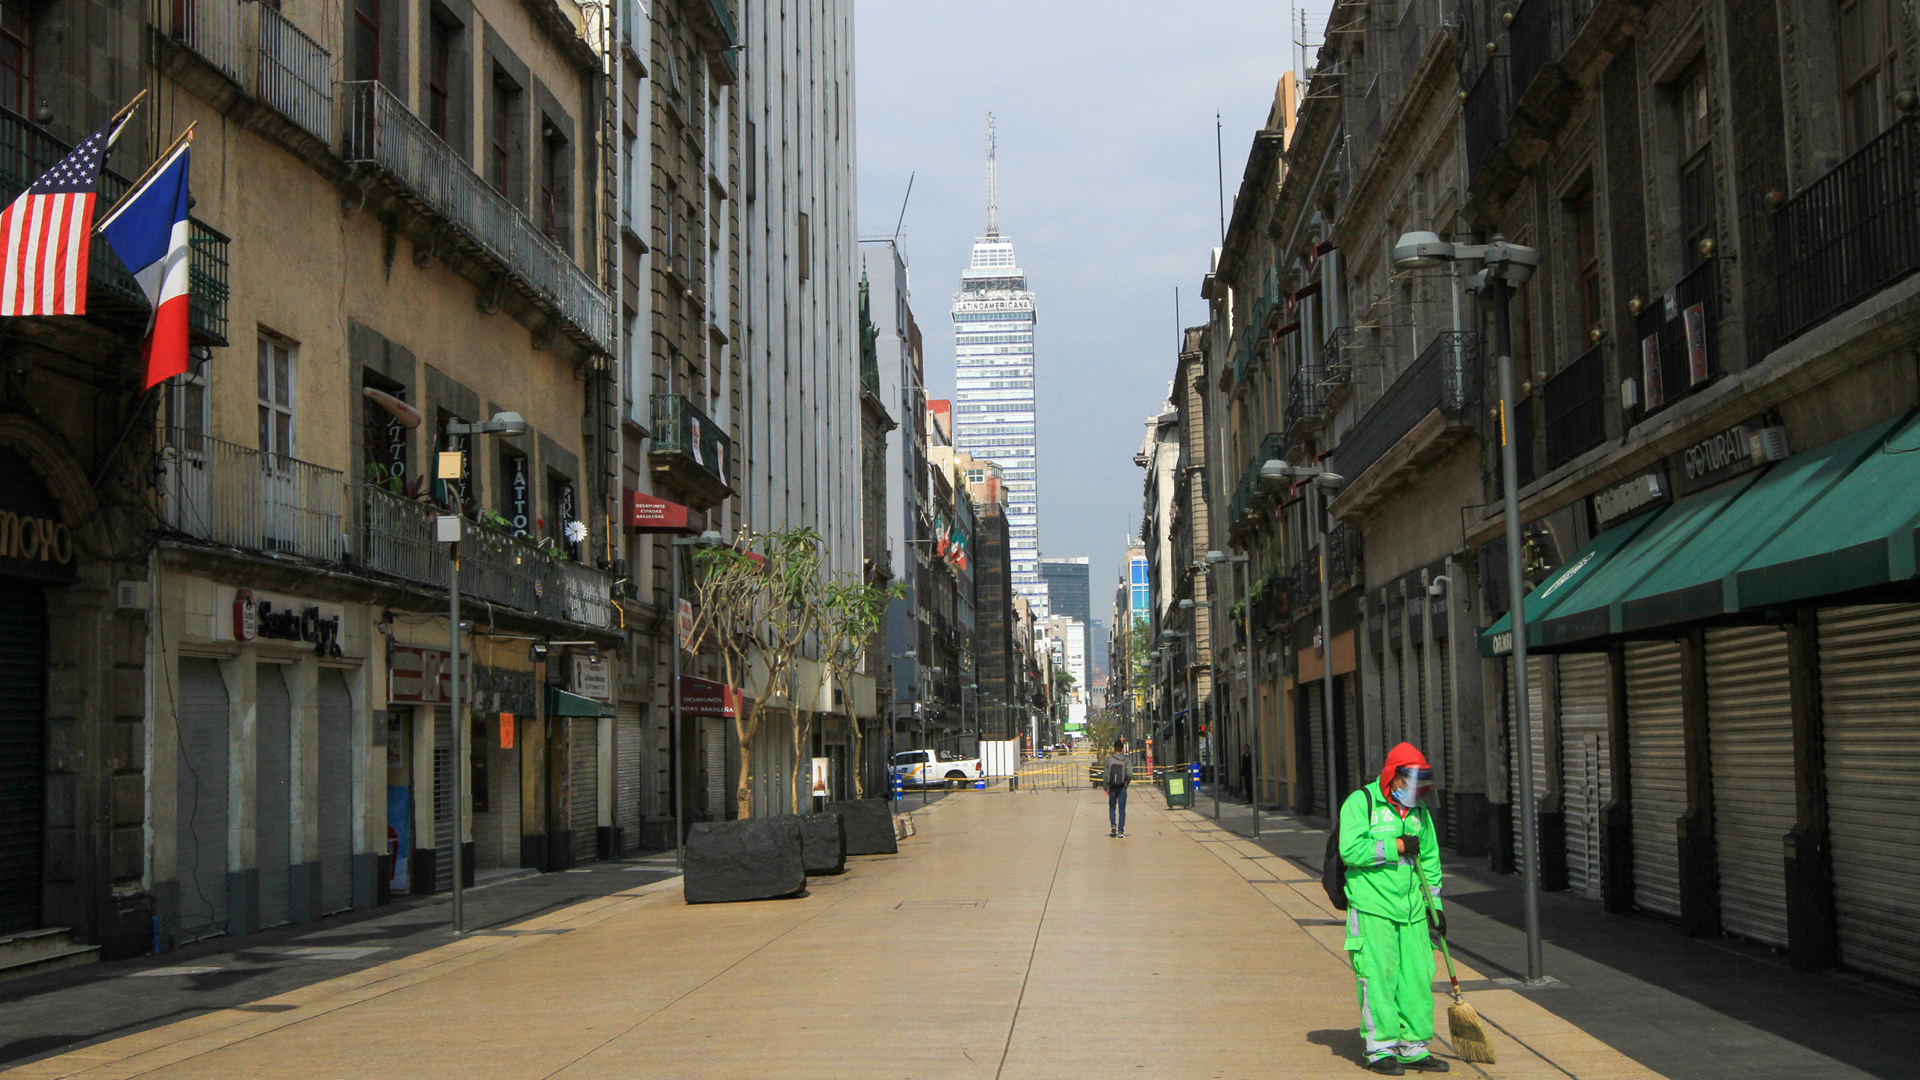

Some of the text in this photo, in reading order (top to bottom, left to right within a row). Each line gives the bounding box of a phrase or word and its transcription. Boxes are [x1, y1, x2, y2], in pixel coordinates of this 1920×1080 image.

[958, 302, 1029, 310] LATINOAMERICANA
[1701, 425, 1747, 472] TURATI
[258, 601, 302, 641] Santa
